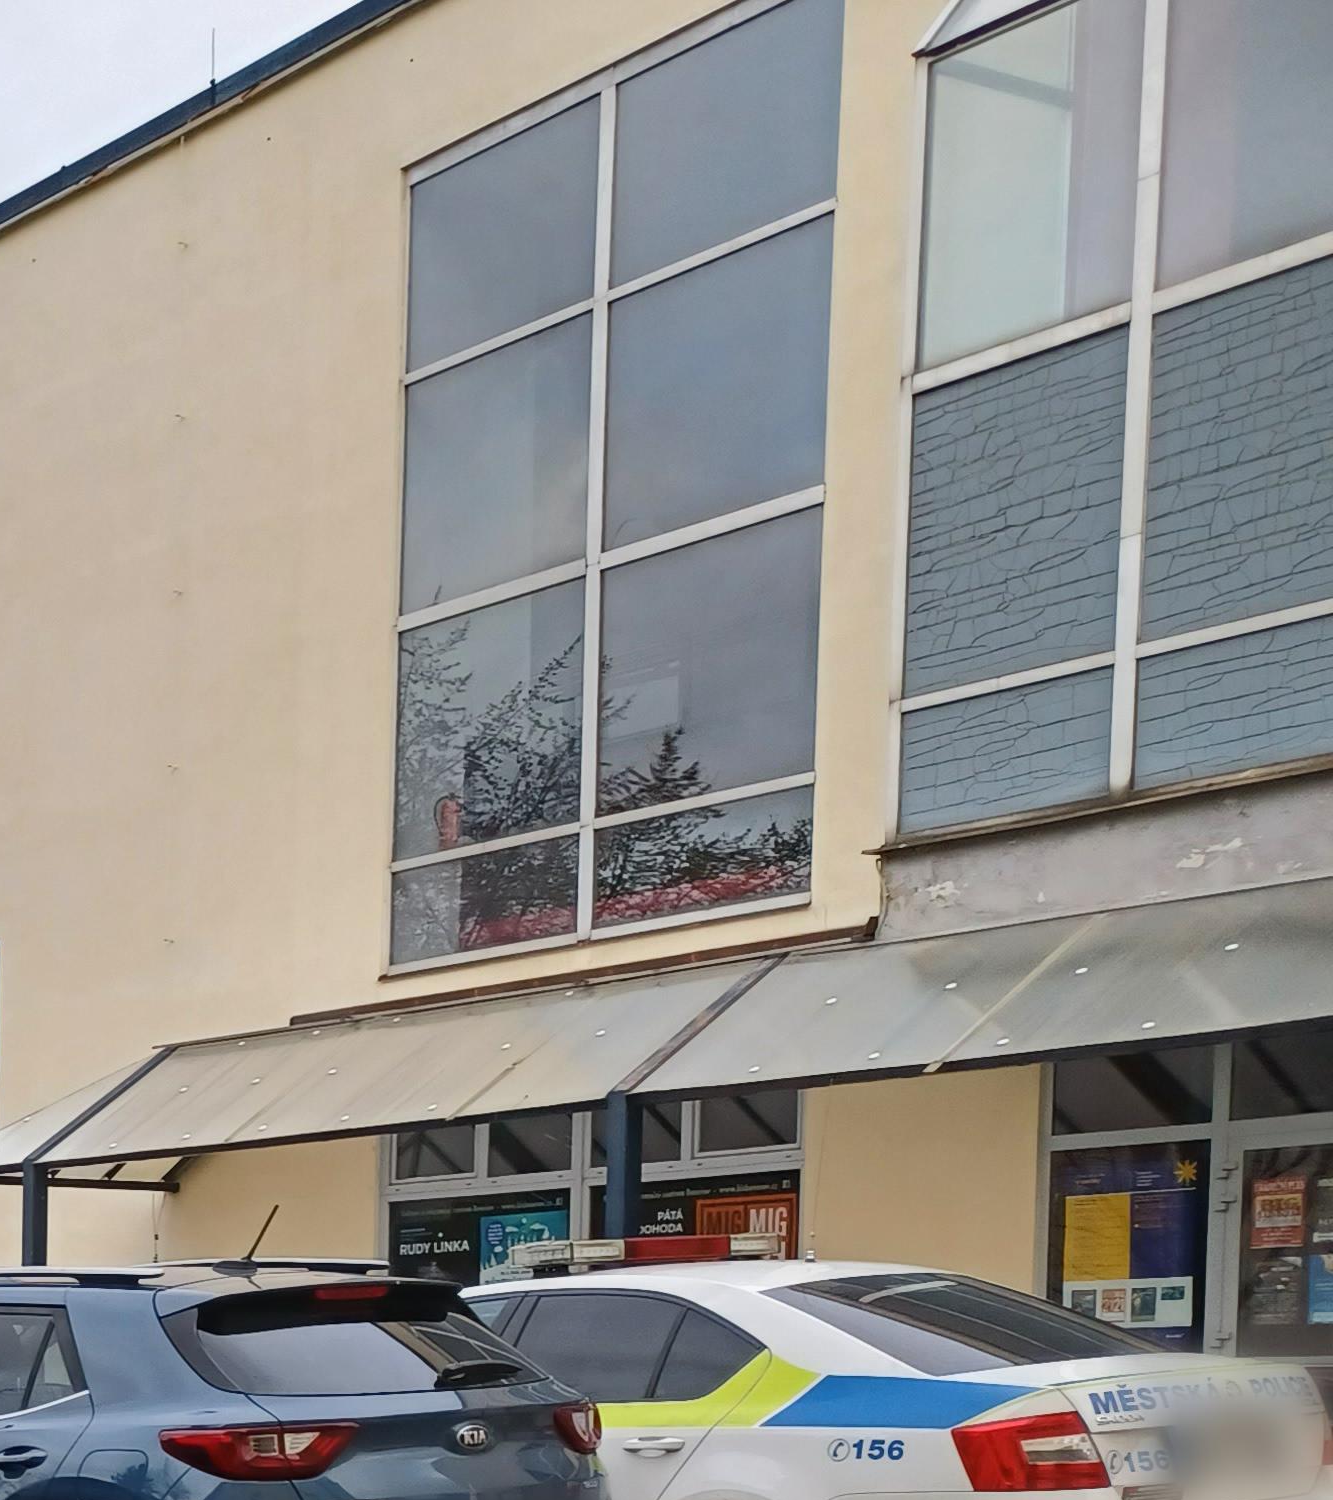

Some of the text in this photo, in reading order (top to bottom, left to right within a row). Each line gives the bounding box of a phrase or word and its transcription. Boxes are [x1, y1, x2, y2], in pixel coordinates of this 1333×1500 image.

[657, 1207, 684, 1221] PÁTÁ
[749, 1207, 788, 1236] MIG
[399, 1239, 470, 1256] RUDY LINKA
[463, 1429, 486, 1445] KIA
[851, 1439, 904, 1461] 156
[1124, 1449, 1170, 1473] 156
